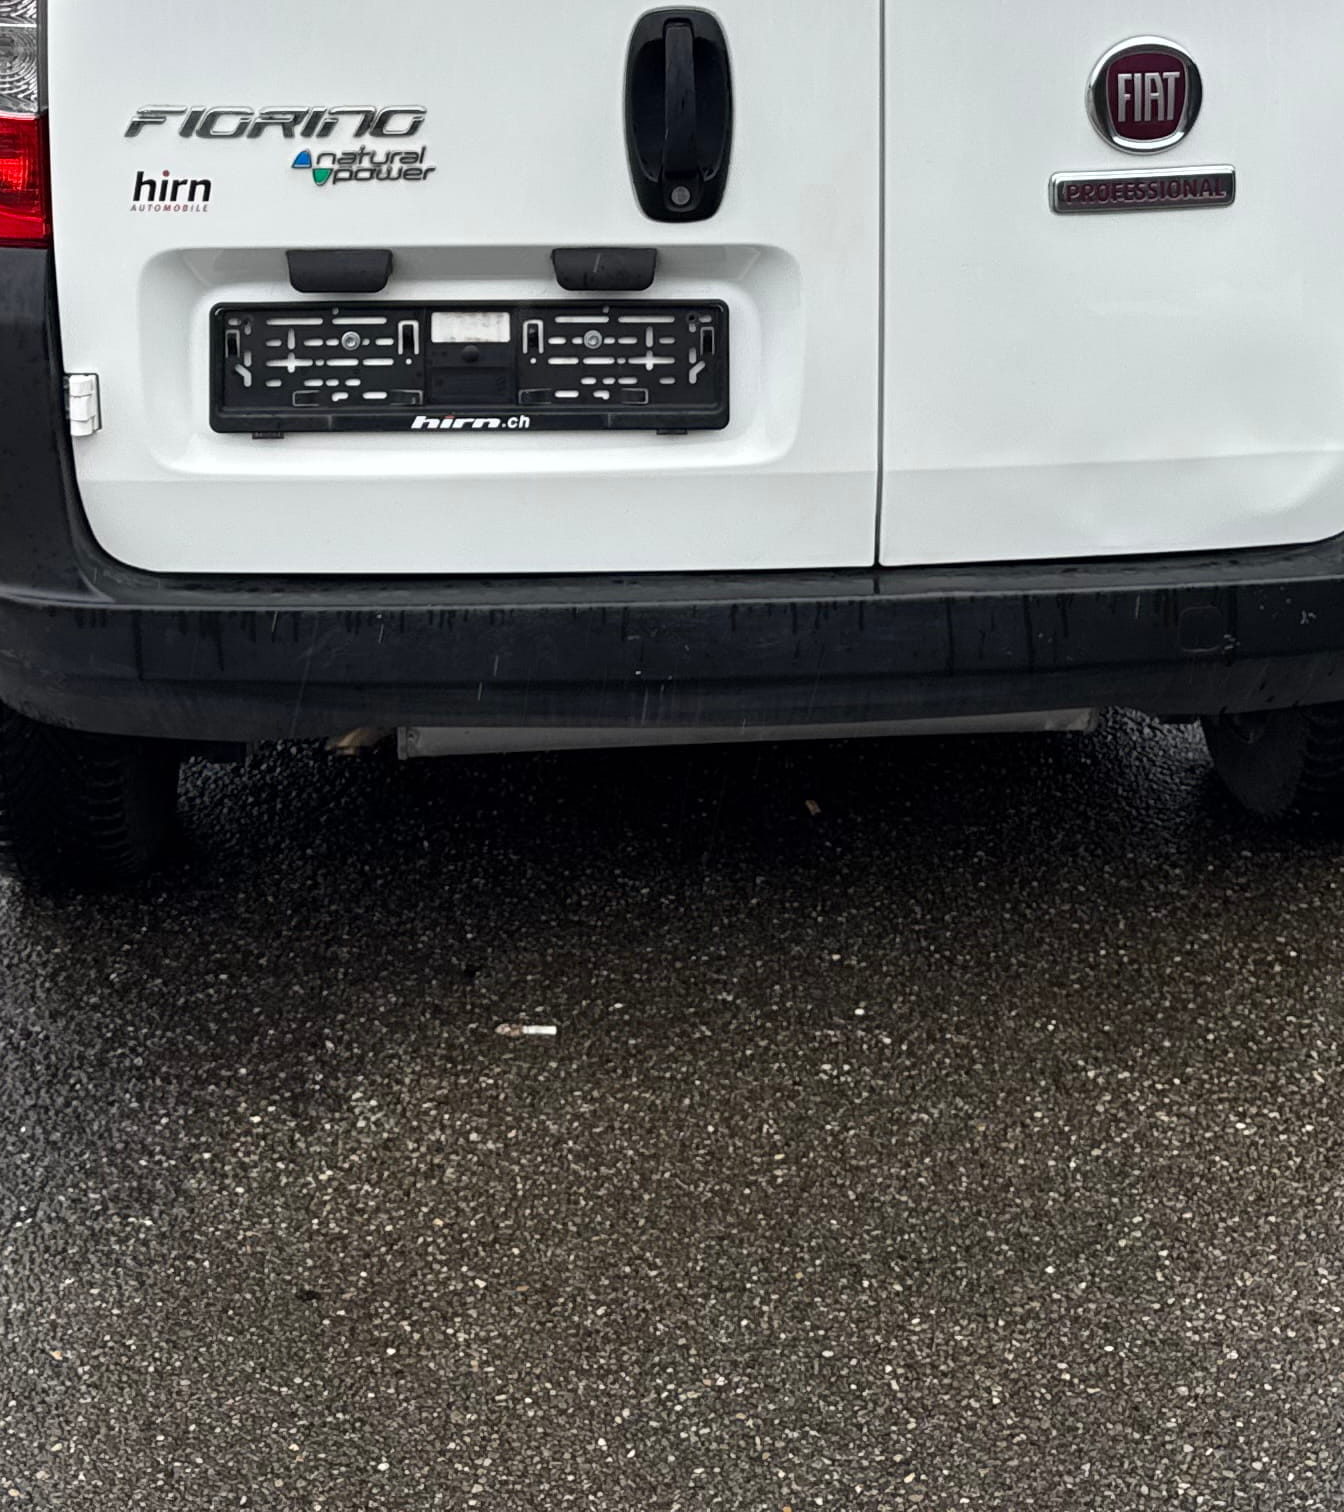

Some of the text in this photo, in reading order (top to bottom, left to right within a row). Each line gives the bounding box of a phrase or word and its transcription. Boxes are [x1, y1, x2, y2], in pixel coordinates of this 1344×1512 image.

[1117, 71, 1181, 123] FIAT
[124, 105, 427, 138] FIORINO
[316, 145, 427, 165] natural
[132, 170, 212, 202] hirn
[332, 165, 437, 185] power
[1064, 178, 1227, 205] PROFESSIONAL
[130, 203, 209, 213] AUTOMOBILE
[411, 414, 531, 429] hirn.ch
